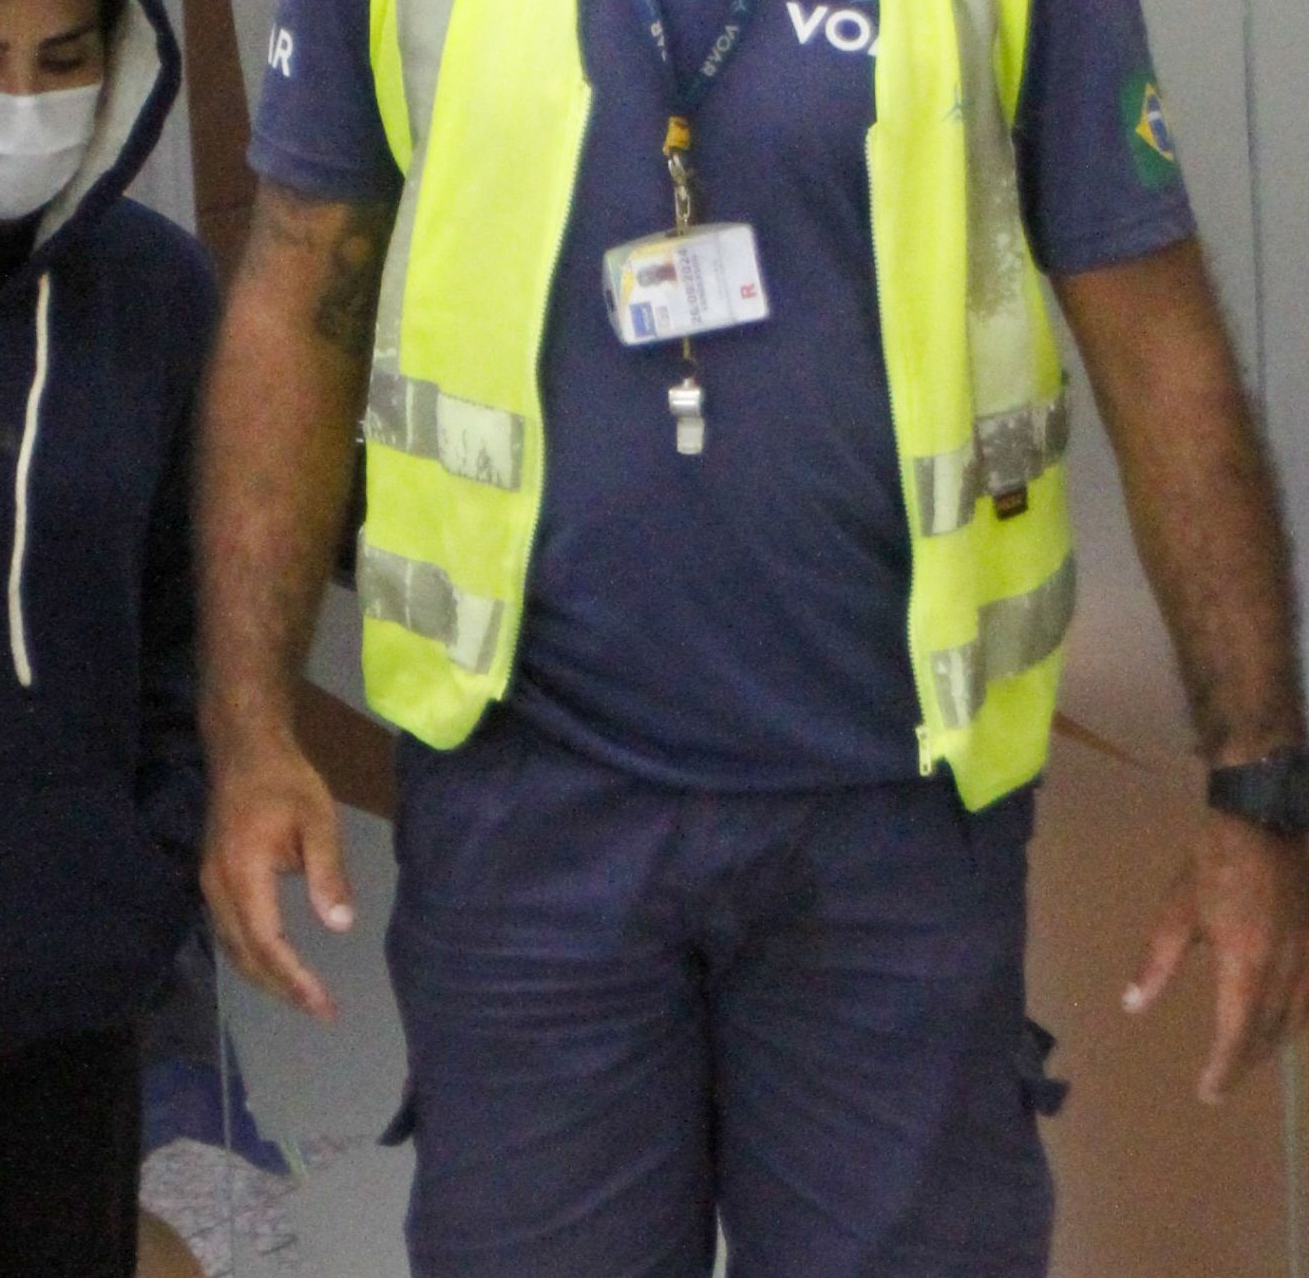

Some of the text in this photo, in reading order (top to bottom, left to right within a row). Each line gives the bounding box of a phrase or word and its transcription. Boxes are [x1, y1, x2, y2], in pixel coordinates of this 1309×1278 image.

[699, 25, 739, 77] VOAR
[786, 1, 877, 56] VO
[739, 281, 757, 299] R
